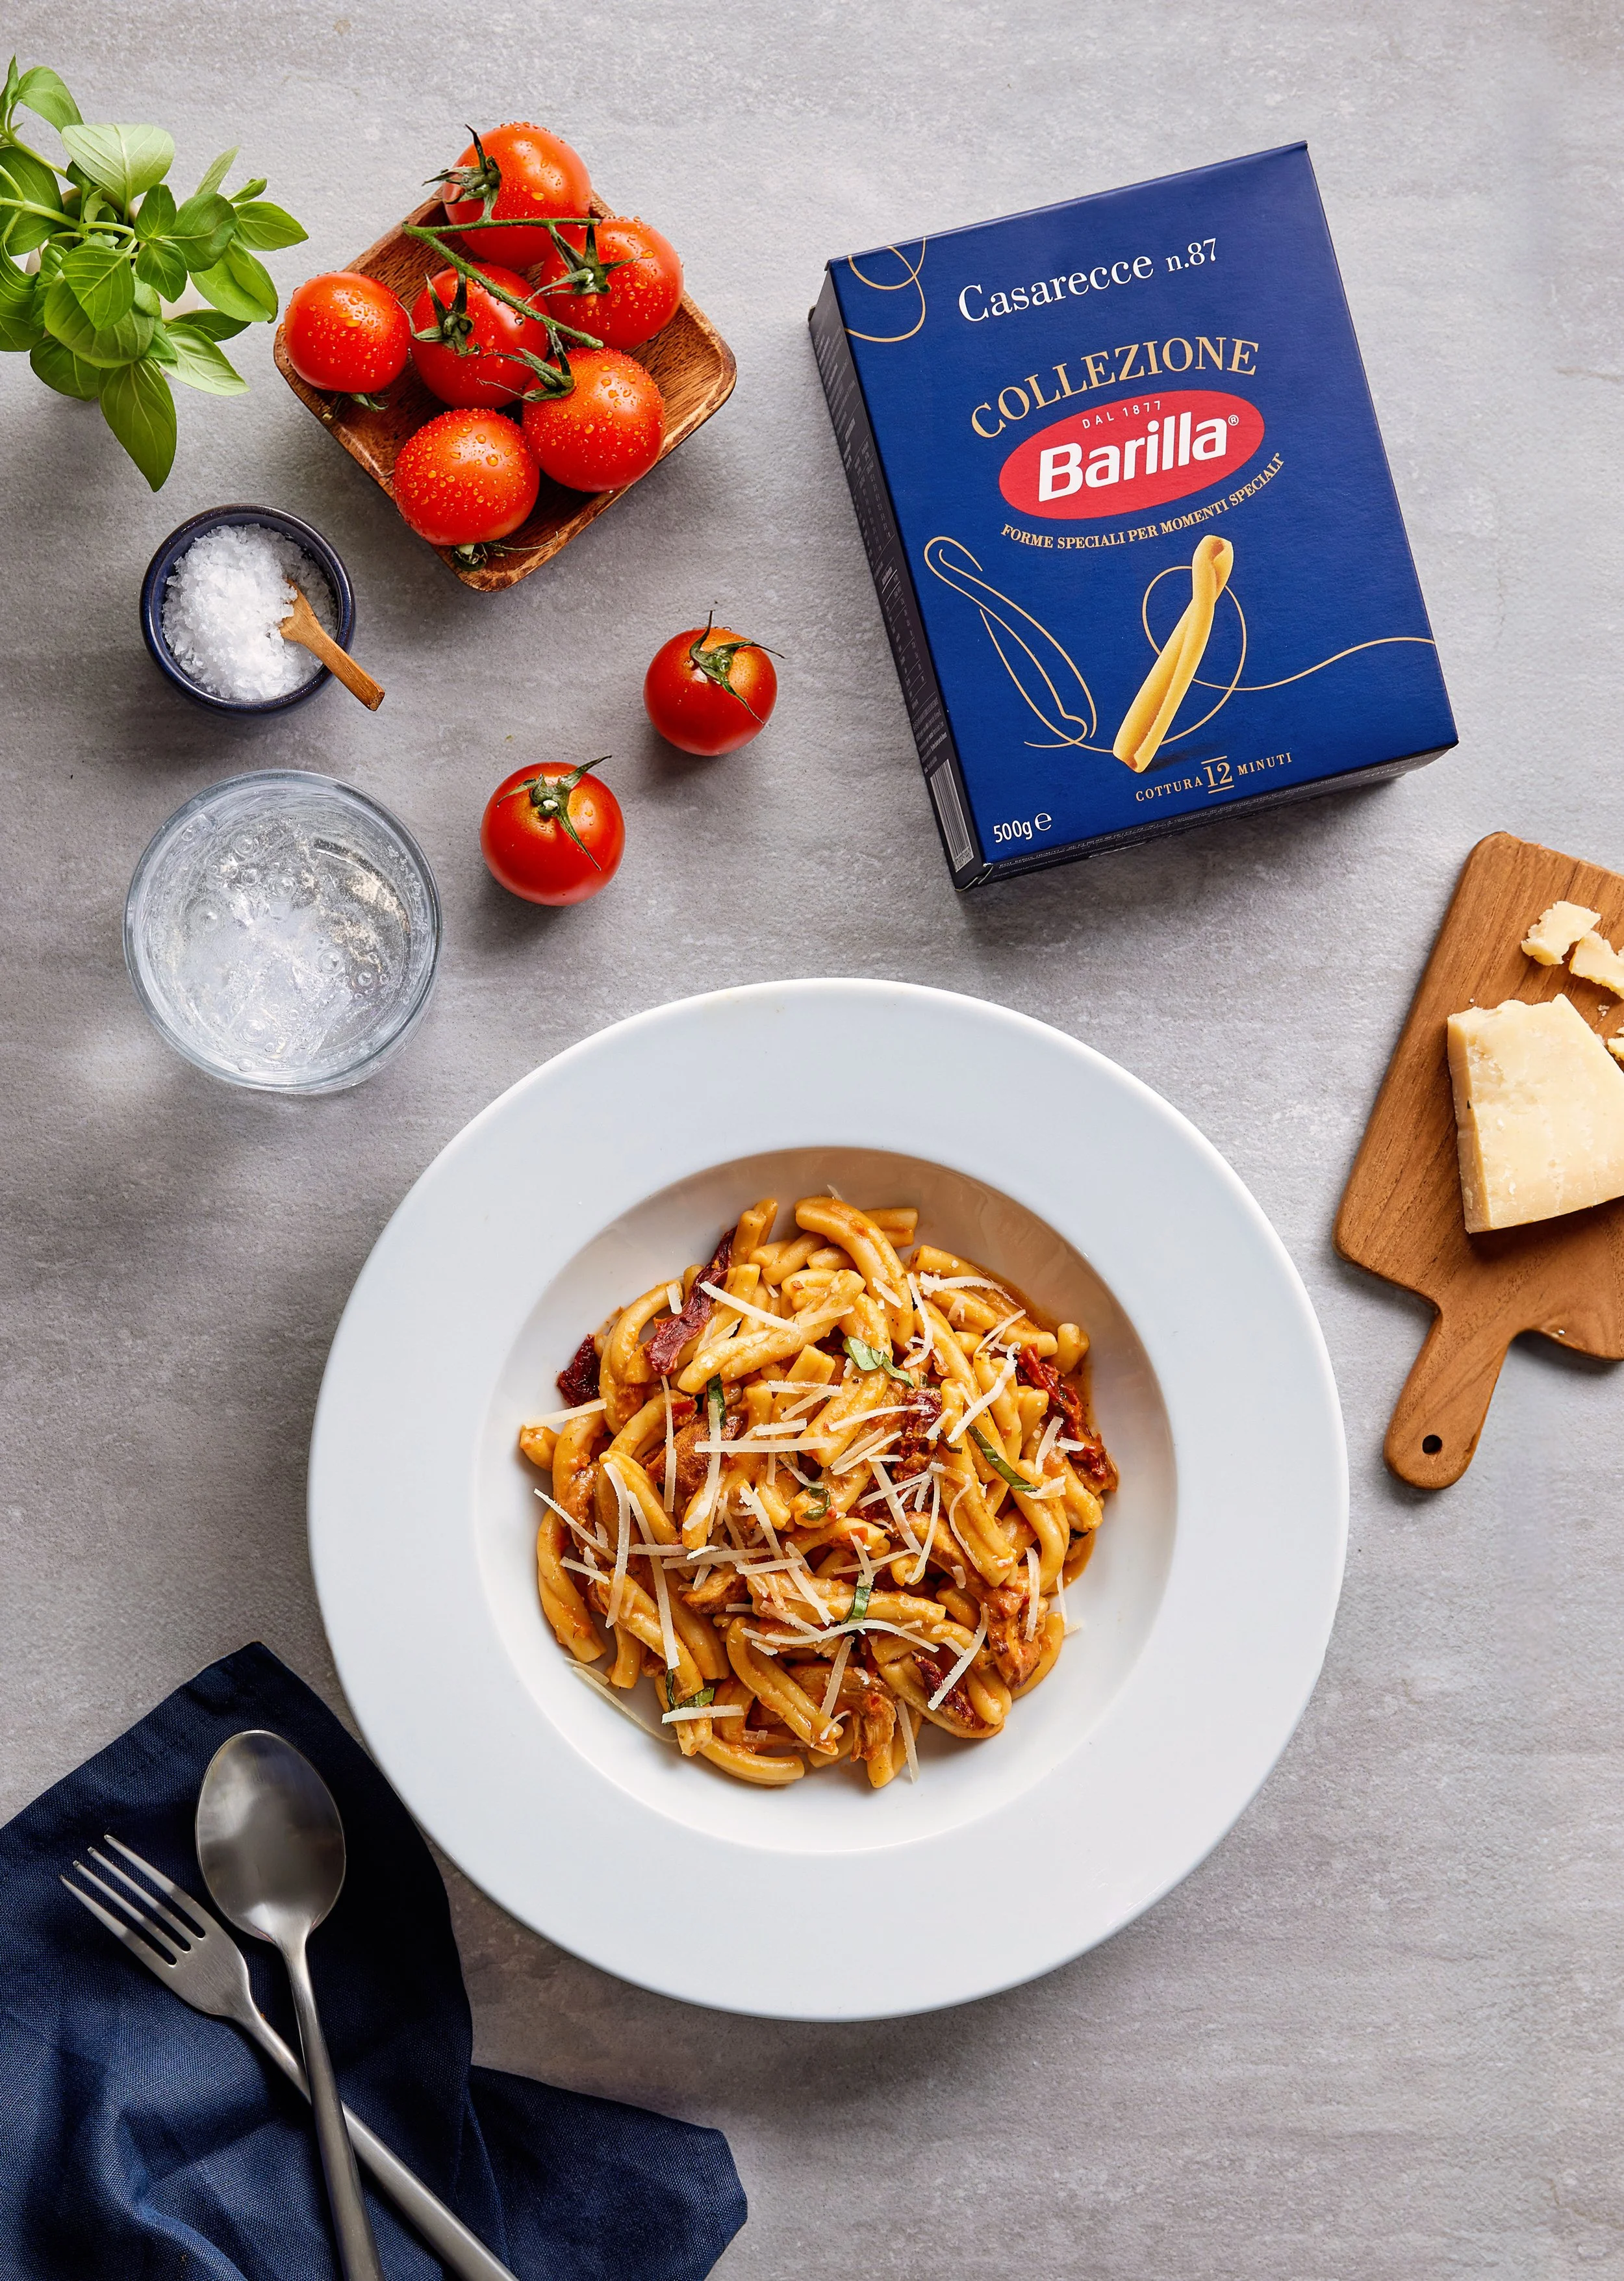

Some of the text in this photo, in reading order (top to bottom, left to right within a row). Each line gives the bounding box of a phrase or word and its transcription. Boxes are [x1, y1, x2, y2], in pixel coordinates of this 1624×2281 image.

[958, 237, 1216, 322] Casarecce n.87
[971, 337, 1259, 438] COLLEZIONE
[1082, 400, 1160, 429] DAL 1877
[1000, 524, 1054, 548] FORME
[1057, 531, 1126, 549] SPECIALI
[1128, 527, 1159, 542] PER
[1159, 498, 1230, 535] MOMENTI
[1136, 752, 1292, 802] COTTURA 12 MINUTI
[993, 820, 1033, 843] 500g
